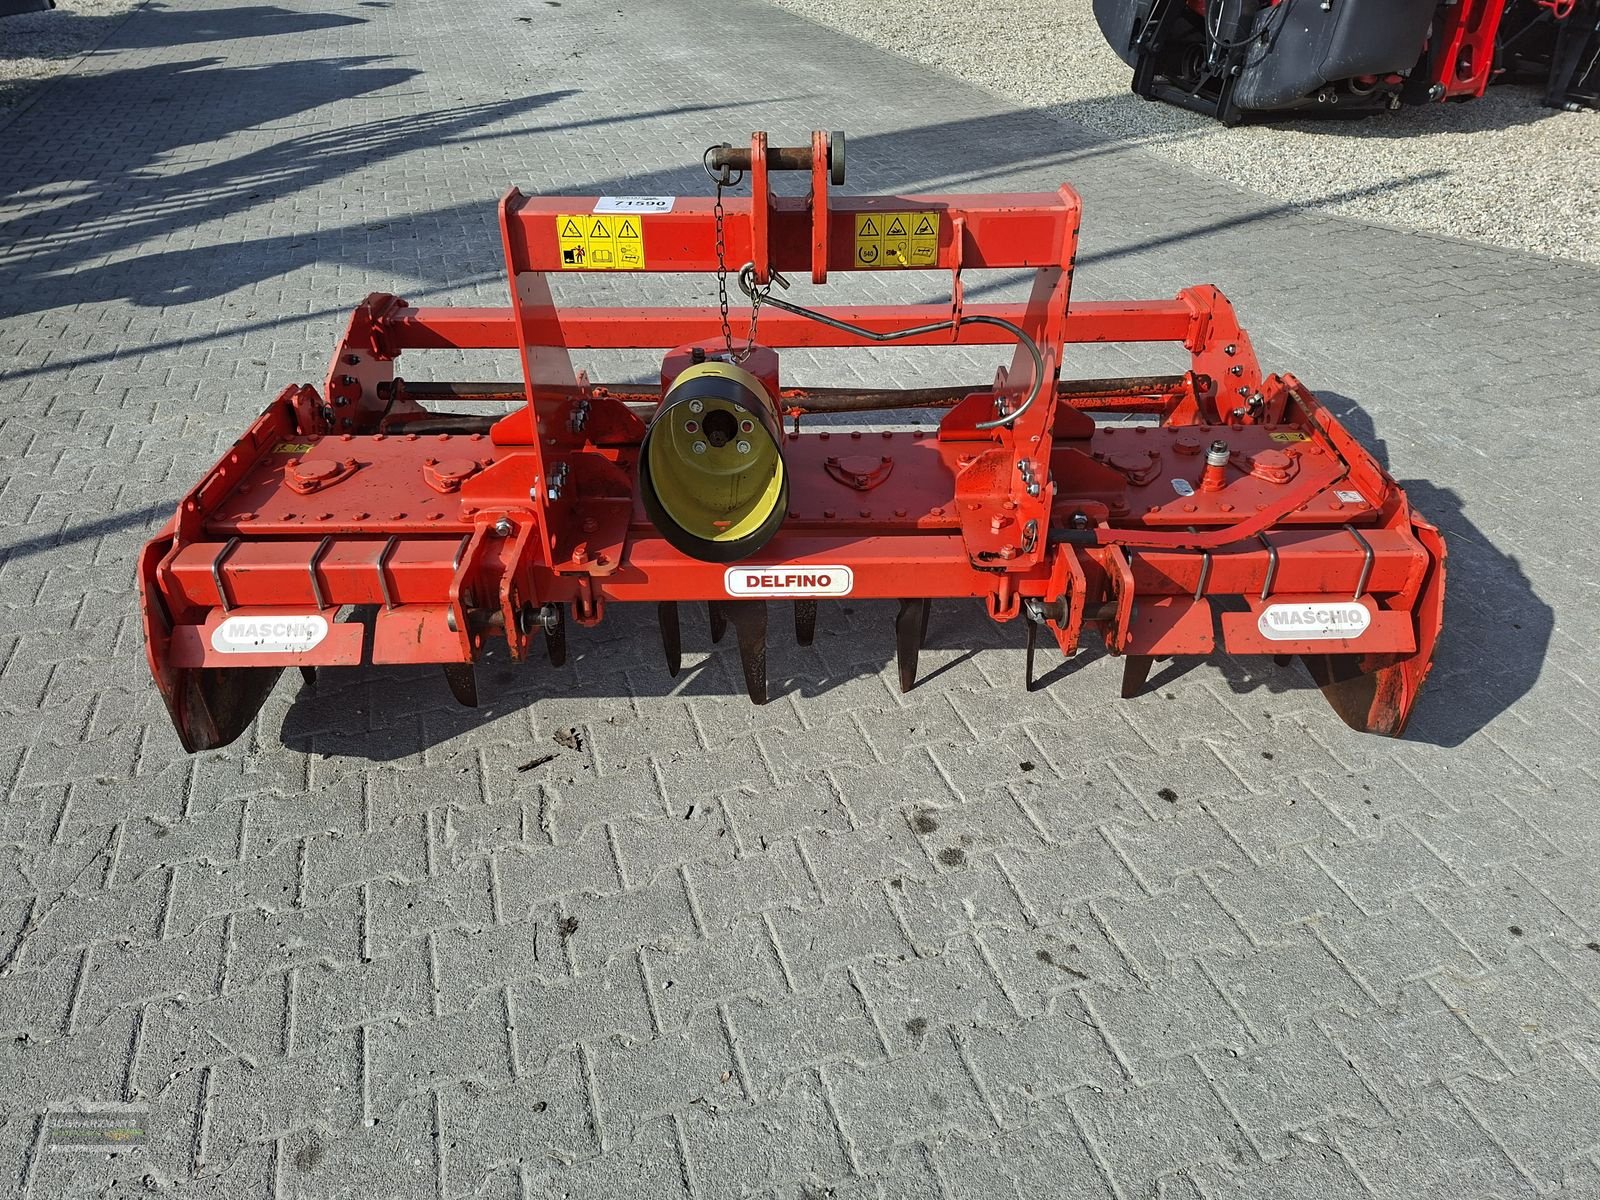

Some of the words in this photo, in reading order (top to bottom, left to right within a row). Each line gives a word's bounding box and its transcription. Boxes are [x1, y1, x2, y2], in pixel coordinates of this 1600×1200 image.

[746, 574, 832, 588] DELFINO
[1272, 609, 1362, 625] MASCHIO
[228, 623, 319, 638] MASCHIO
